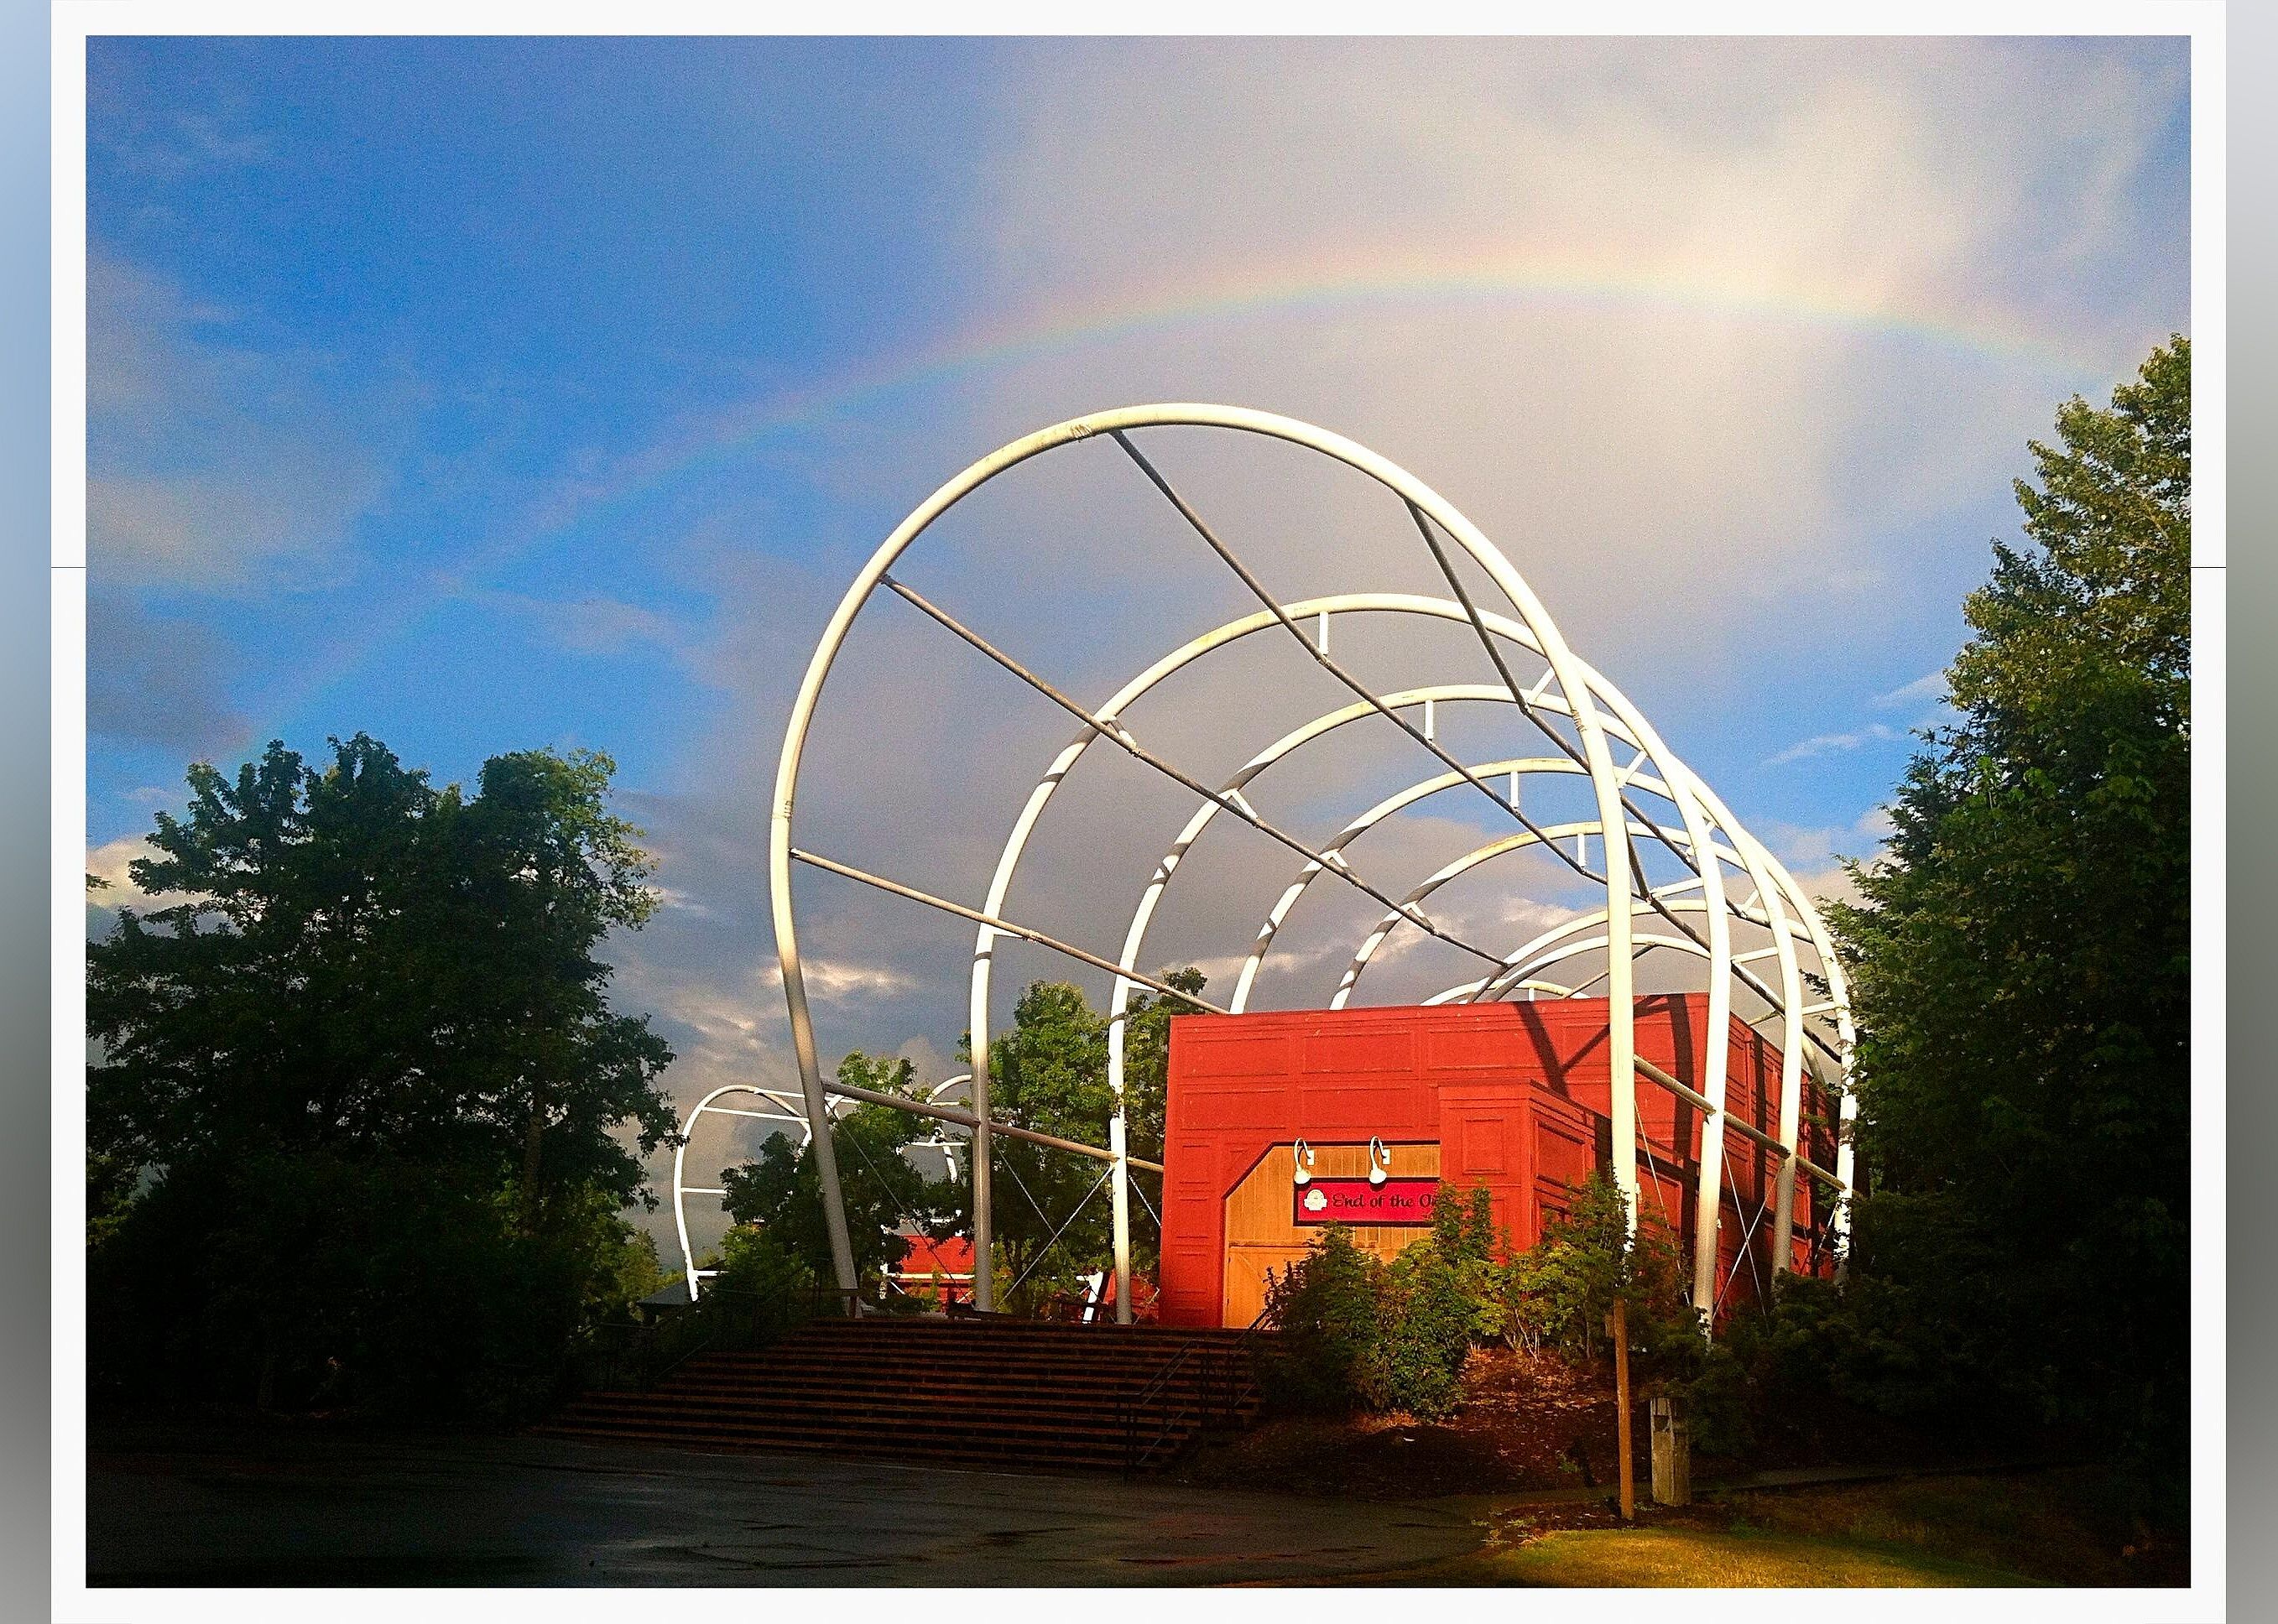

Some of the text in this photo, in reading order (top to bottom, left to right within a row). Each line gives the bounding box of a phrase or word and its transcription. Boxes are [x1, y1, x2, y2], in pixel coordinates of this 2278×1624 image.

[1332, 1194, 1364, 1208] End
[1369, 1195, 1385, 1208] of
[1389, 1194, 1414, 1208] the
